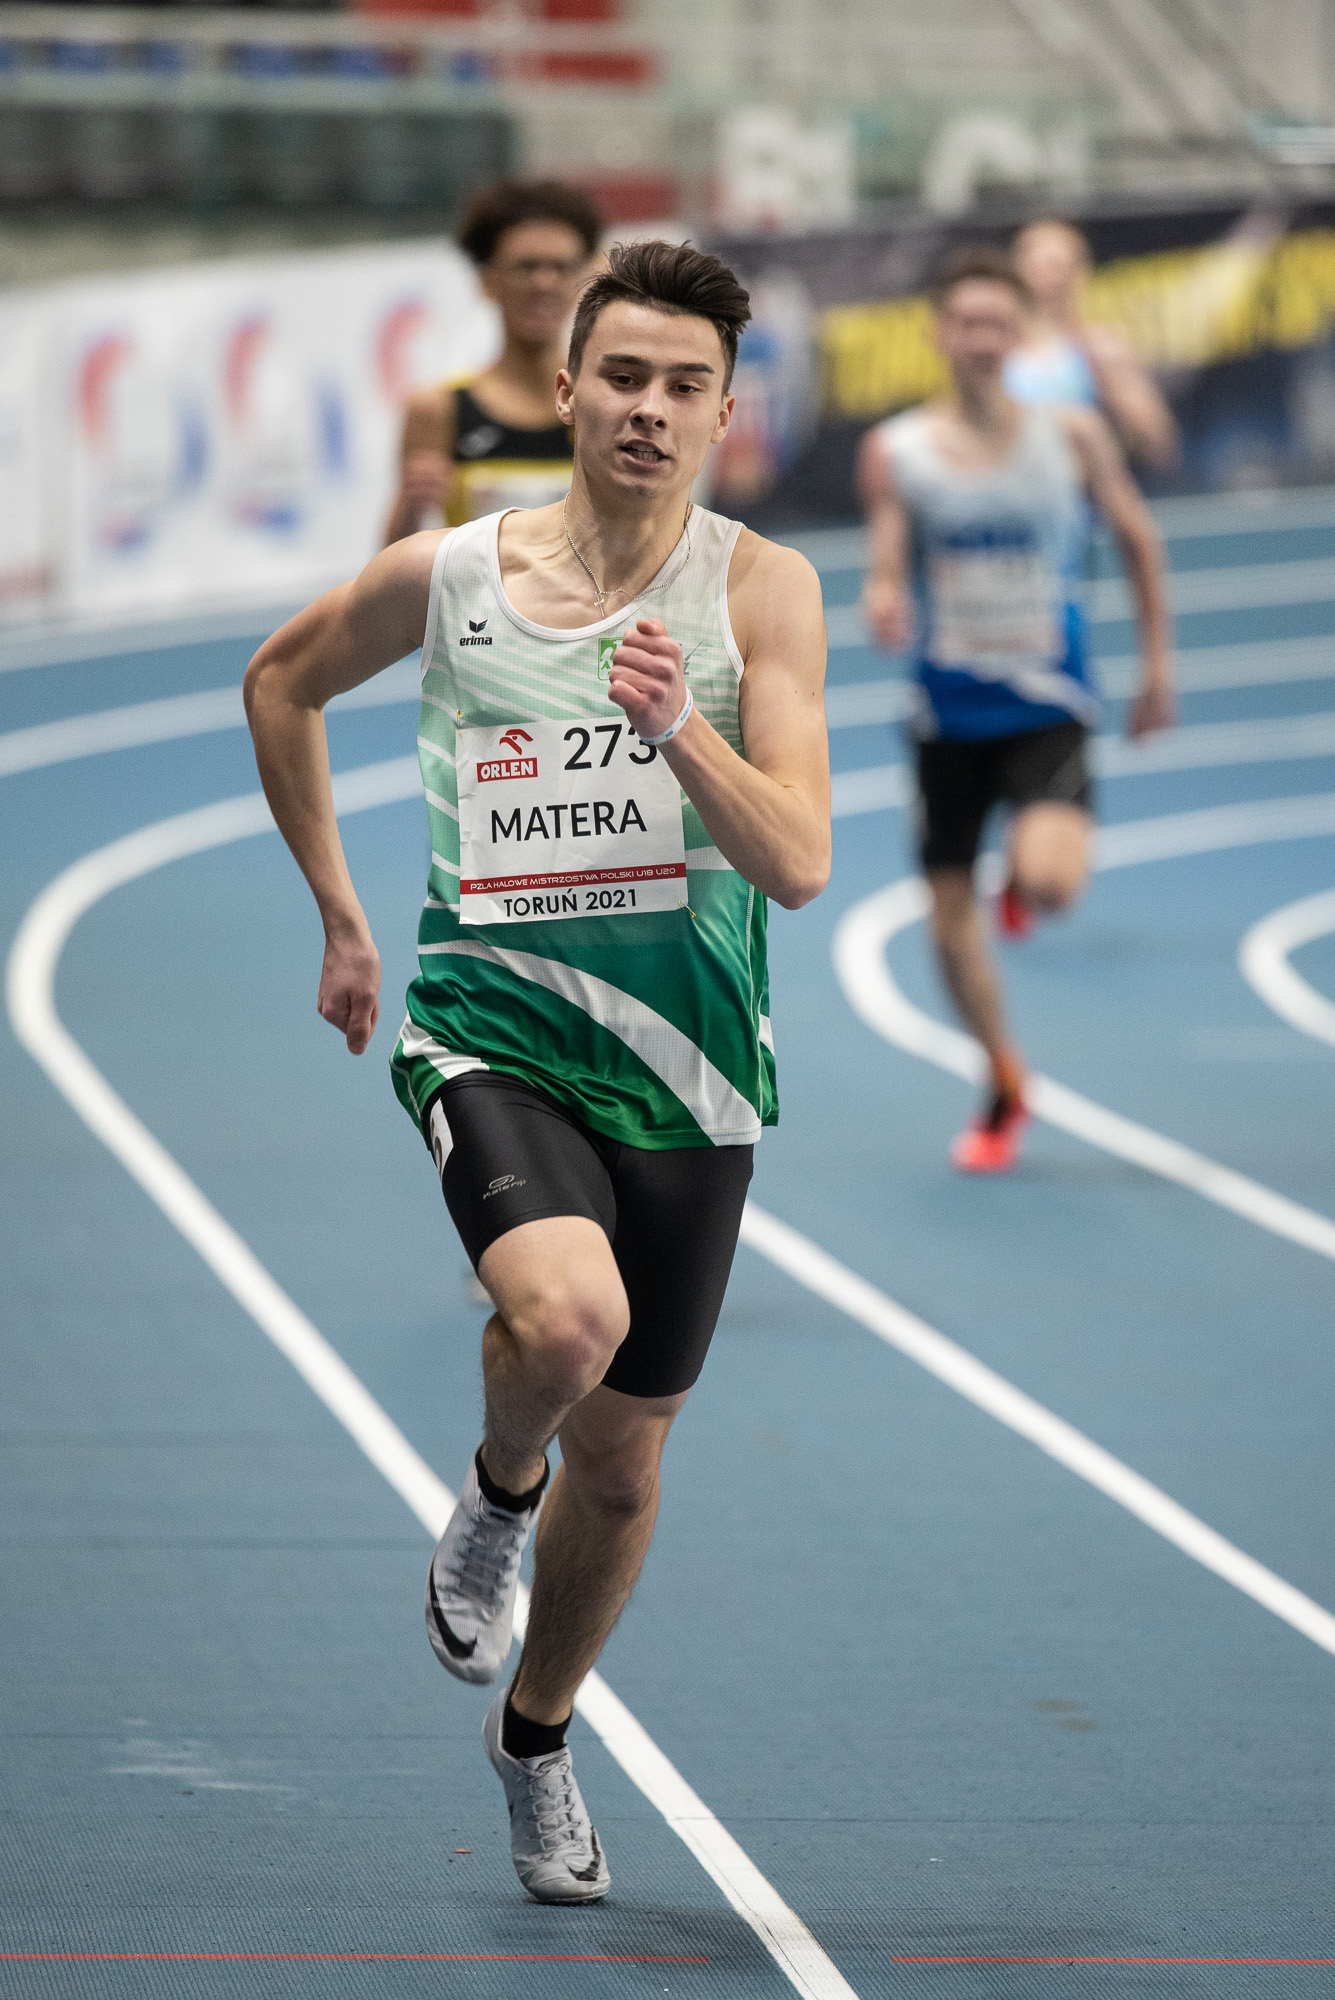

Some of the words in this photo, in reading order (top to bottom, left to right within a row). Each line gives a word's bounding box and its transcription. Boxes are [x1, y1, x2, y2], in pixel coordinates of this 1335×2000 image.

[459, 635, 493, 647] erima
[563, 723, 658, 771] 273
[480, 760, 534, 780] ORLEN
[490, 798, 648, 844] MATERA
[470, 882, 493, 891] PZLA
[493, 878, 528, 889] HALOWE
[529, 872, 599, 886] MISTRZOSTWA
[600, 870, 635, 880] POLSKI
[655, 866, 676, 876] U20
[503, 887, 579, 918] TORUŃ
[585, 888, 637, 911] 2021
